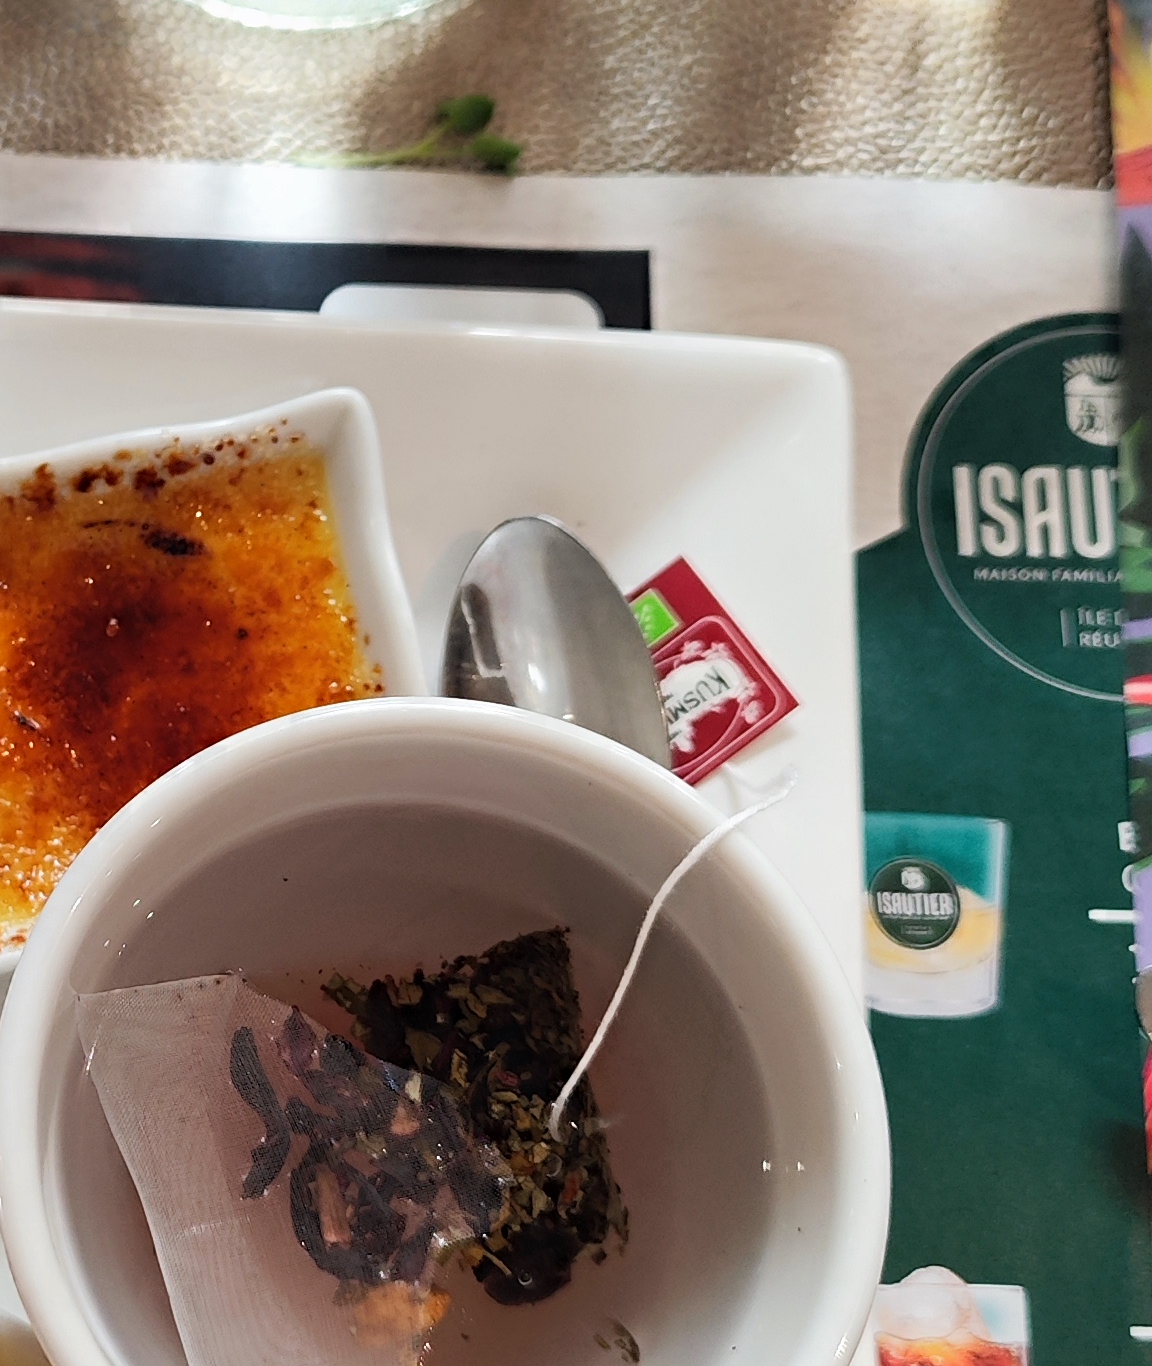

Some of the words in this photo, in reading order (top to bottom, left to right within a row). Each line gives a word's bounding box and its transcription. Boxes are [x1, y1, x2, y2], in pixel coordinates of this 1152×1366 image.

[952, 462, 1120, 559] ISAU
[974, 566, 1047, 582] MAISON
[876, 890, 954, 915] ISAUTIER
